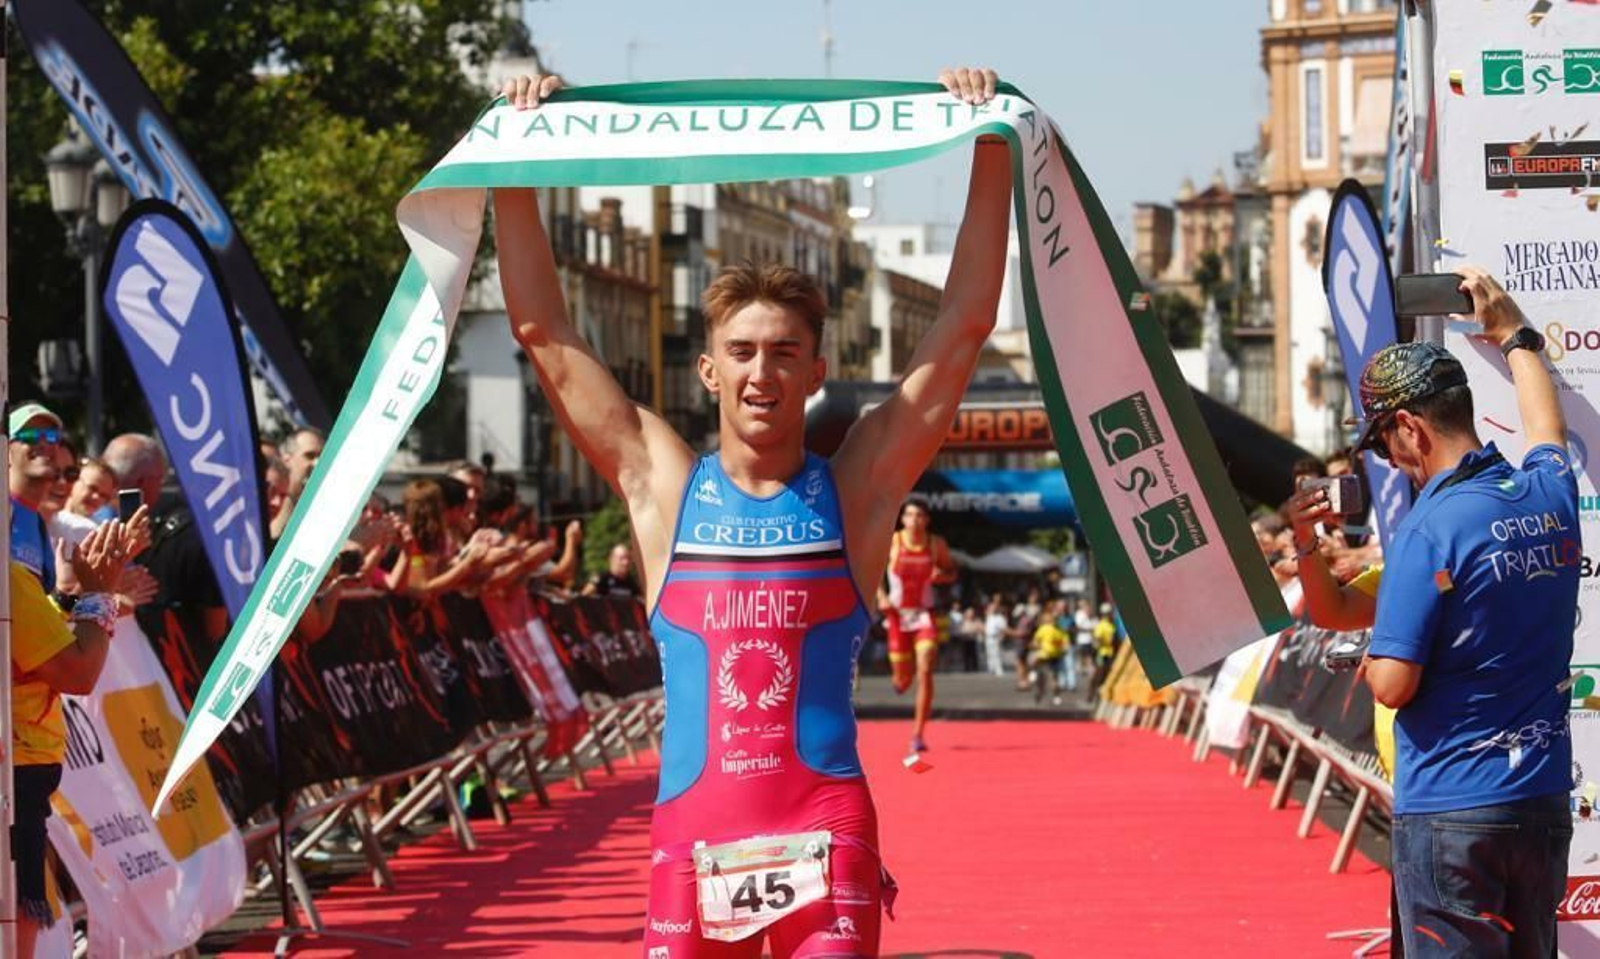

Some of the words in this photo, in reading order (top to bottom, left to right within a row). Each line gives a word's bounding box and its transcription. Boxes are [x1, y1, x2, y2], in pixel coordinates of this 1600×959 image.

[524, 103, 825, 137] ANDALUZA
[851, 101, 913, 131] DE
[1503, 240, 1599, 276] MERCADO
[694, 519, 824, 545] CREDUS
[1491, 512, 1569, 542] OFICIAL
[1481, 538, 1580, 582] TRIATLO
[703, 581, 808, 632] A.JIMÉNEZ
[731, 871, 796, 913] 45
